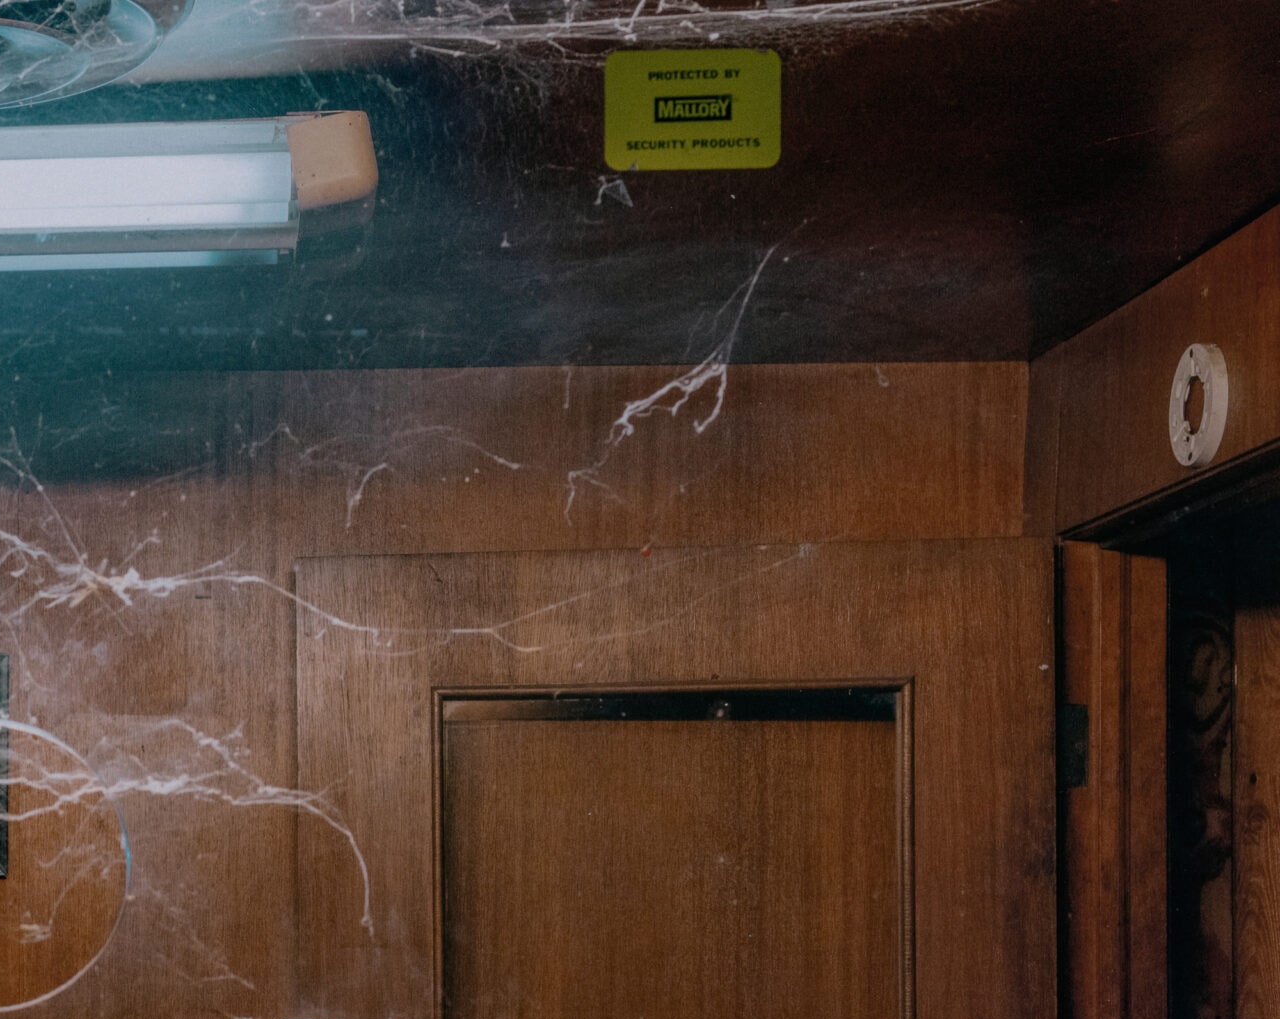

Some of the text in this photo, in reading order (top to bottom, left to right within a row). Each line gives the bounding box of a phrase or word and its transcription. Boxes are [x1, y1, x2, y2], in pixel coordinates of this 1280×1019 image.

[648, 69, 741, 81] PROTECTED BY
[658, 99, 729, 119] MALLORY
[626, 137, 761, 151] SECURITY PRODUCTS
